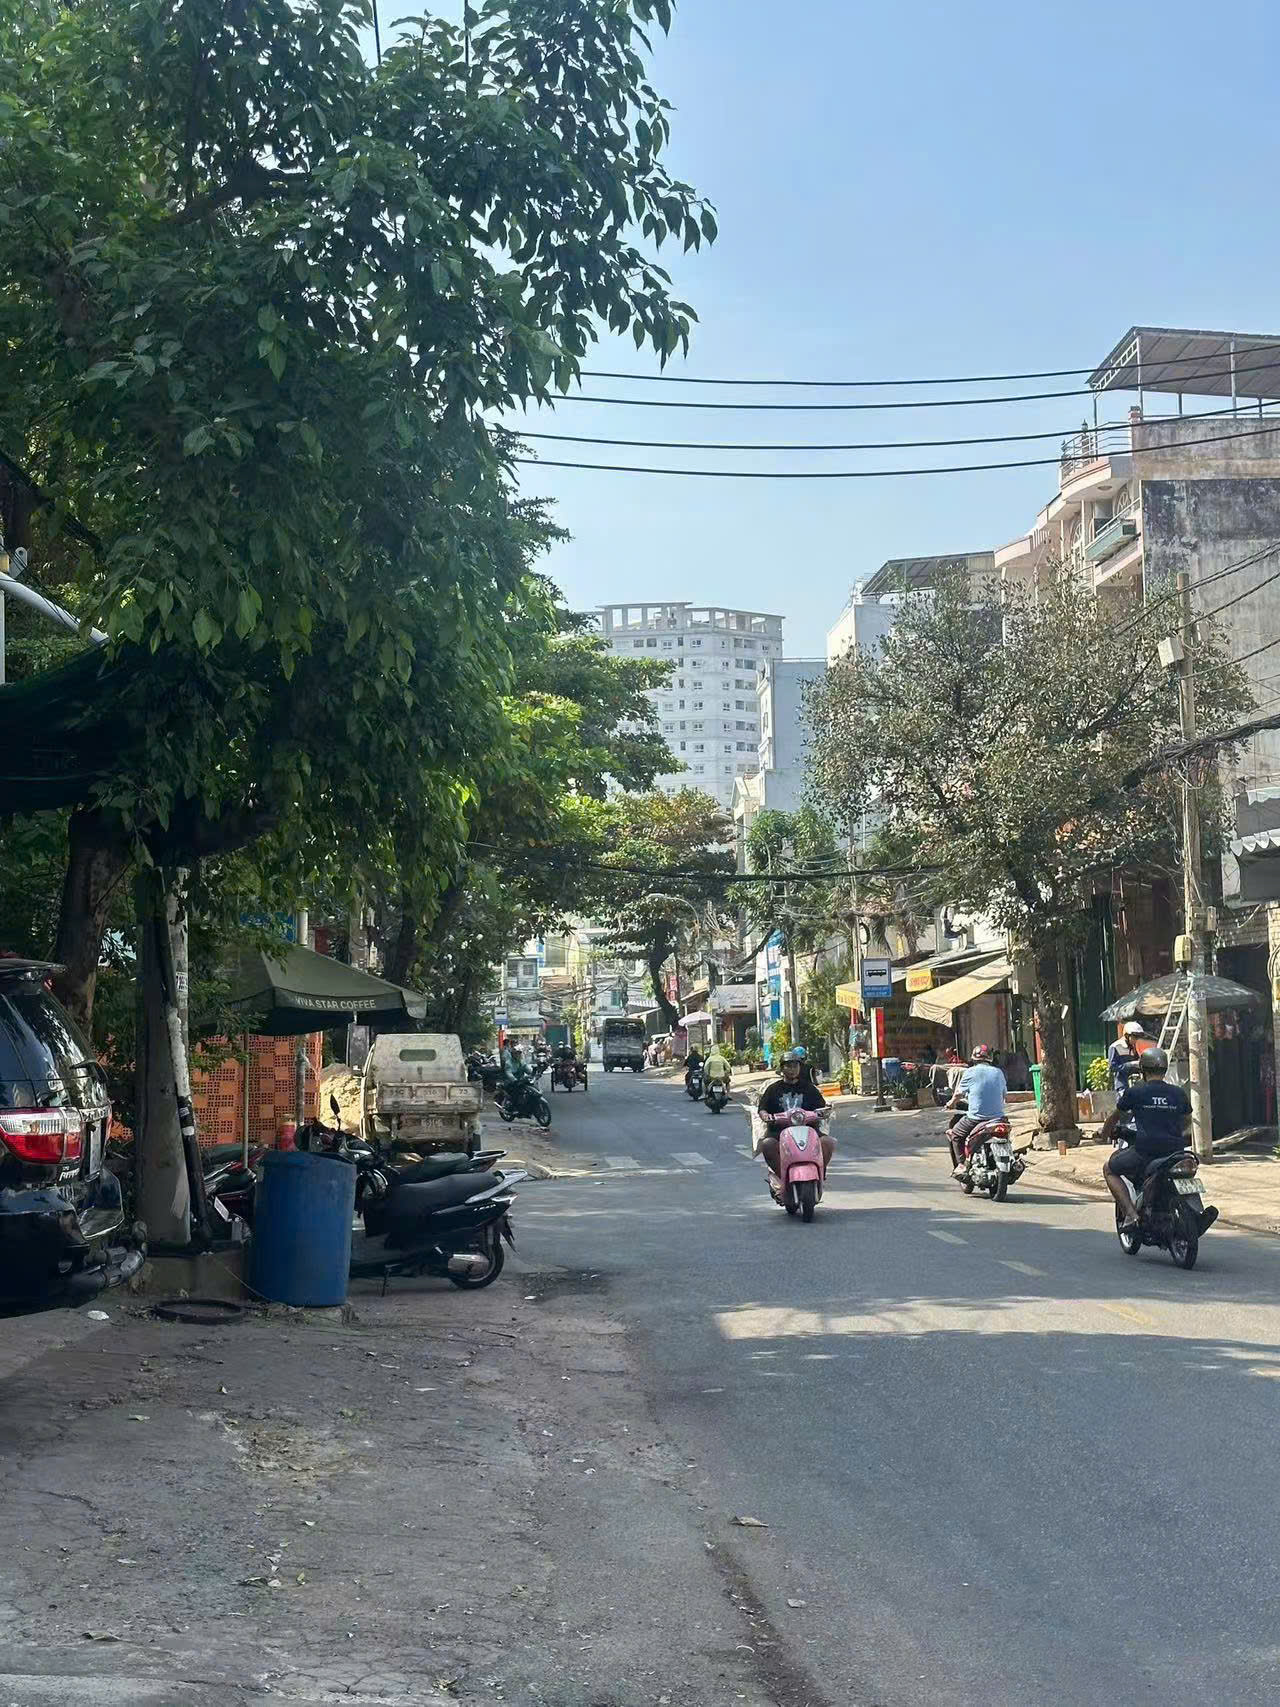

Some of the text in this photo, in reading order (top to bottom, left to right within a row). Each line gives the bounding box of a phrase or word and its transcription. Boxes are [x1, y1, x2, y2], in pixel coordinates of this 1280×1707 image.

[294, 995, 377, 1009] VIVA STAR COFFEE
